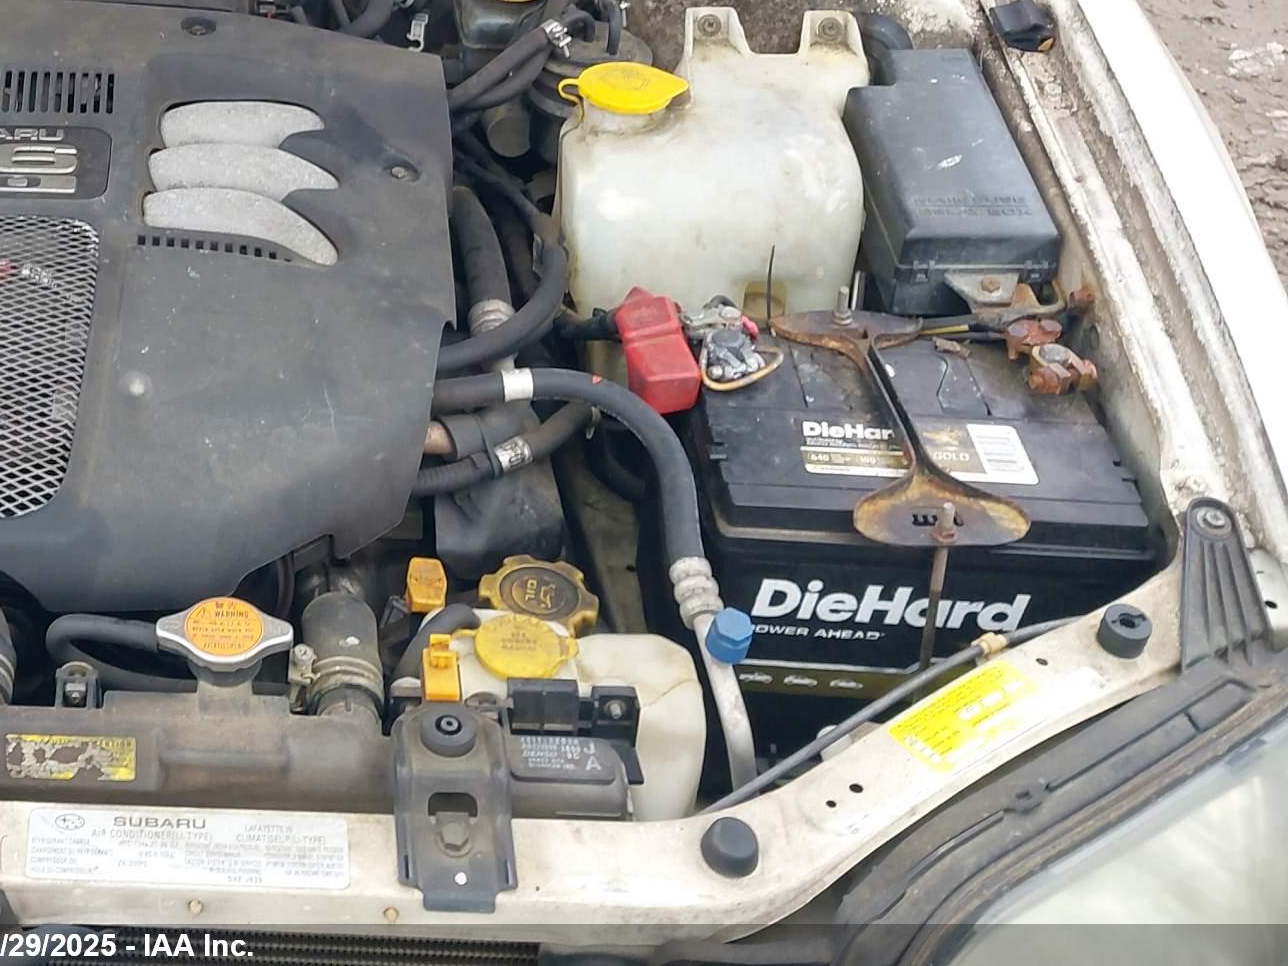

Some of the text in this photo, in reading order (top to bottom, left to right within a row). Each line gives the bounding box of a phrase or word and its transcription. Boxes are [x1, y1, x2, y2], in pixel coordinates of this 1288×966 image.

[802, 421, 895, 440] DieHar
[751, 578, 1031, 633] DieHard
[585, 755, 602, 770] A
[113, 815, 208, 831] SUBARU
